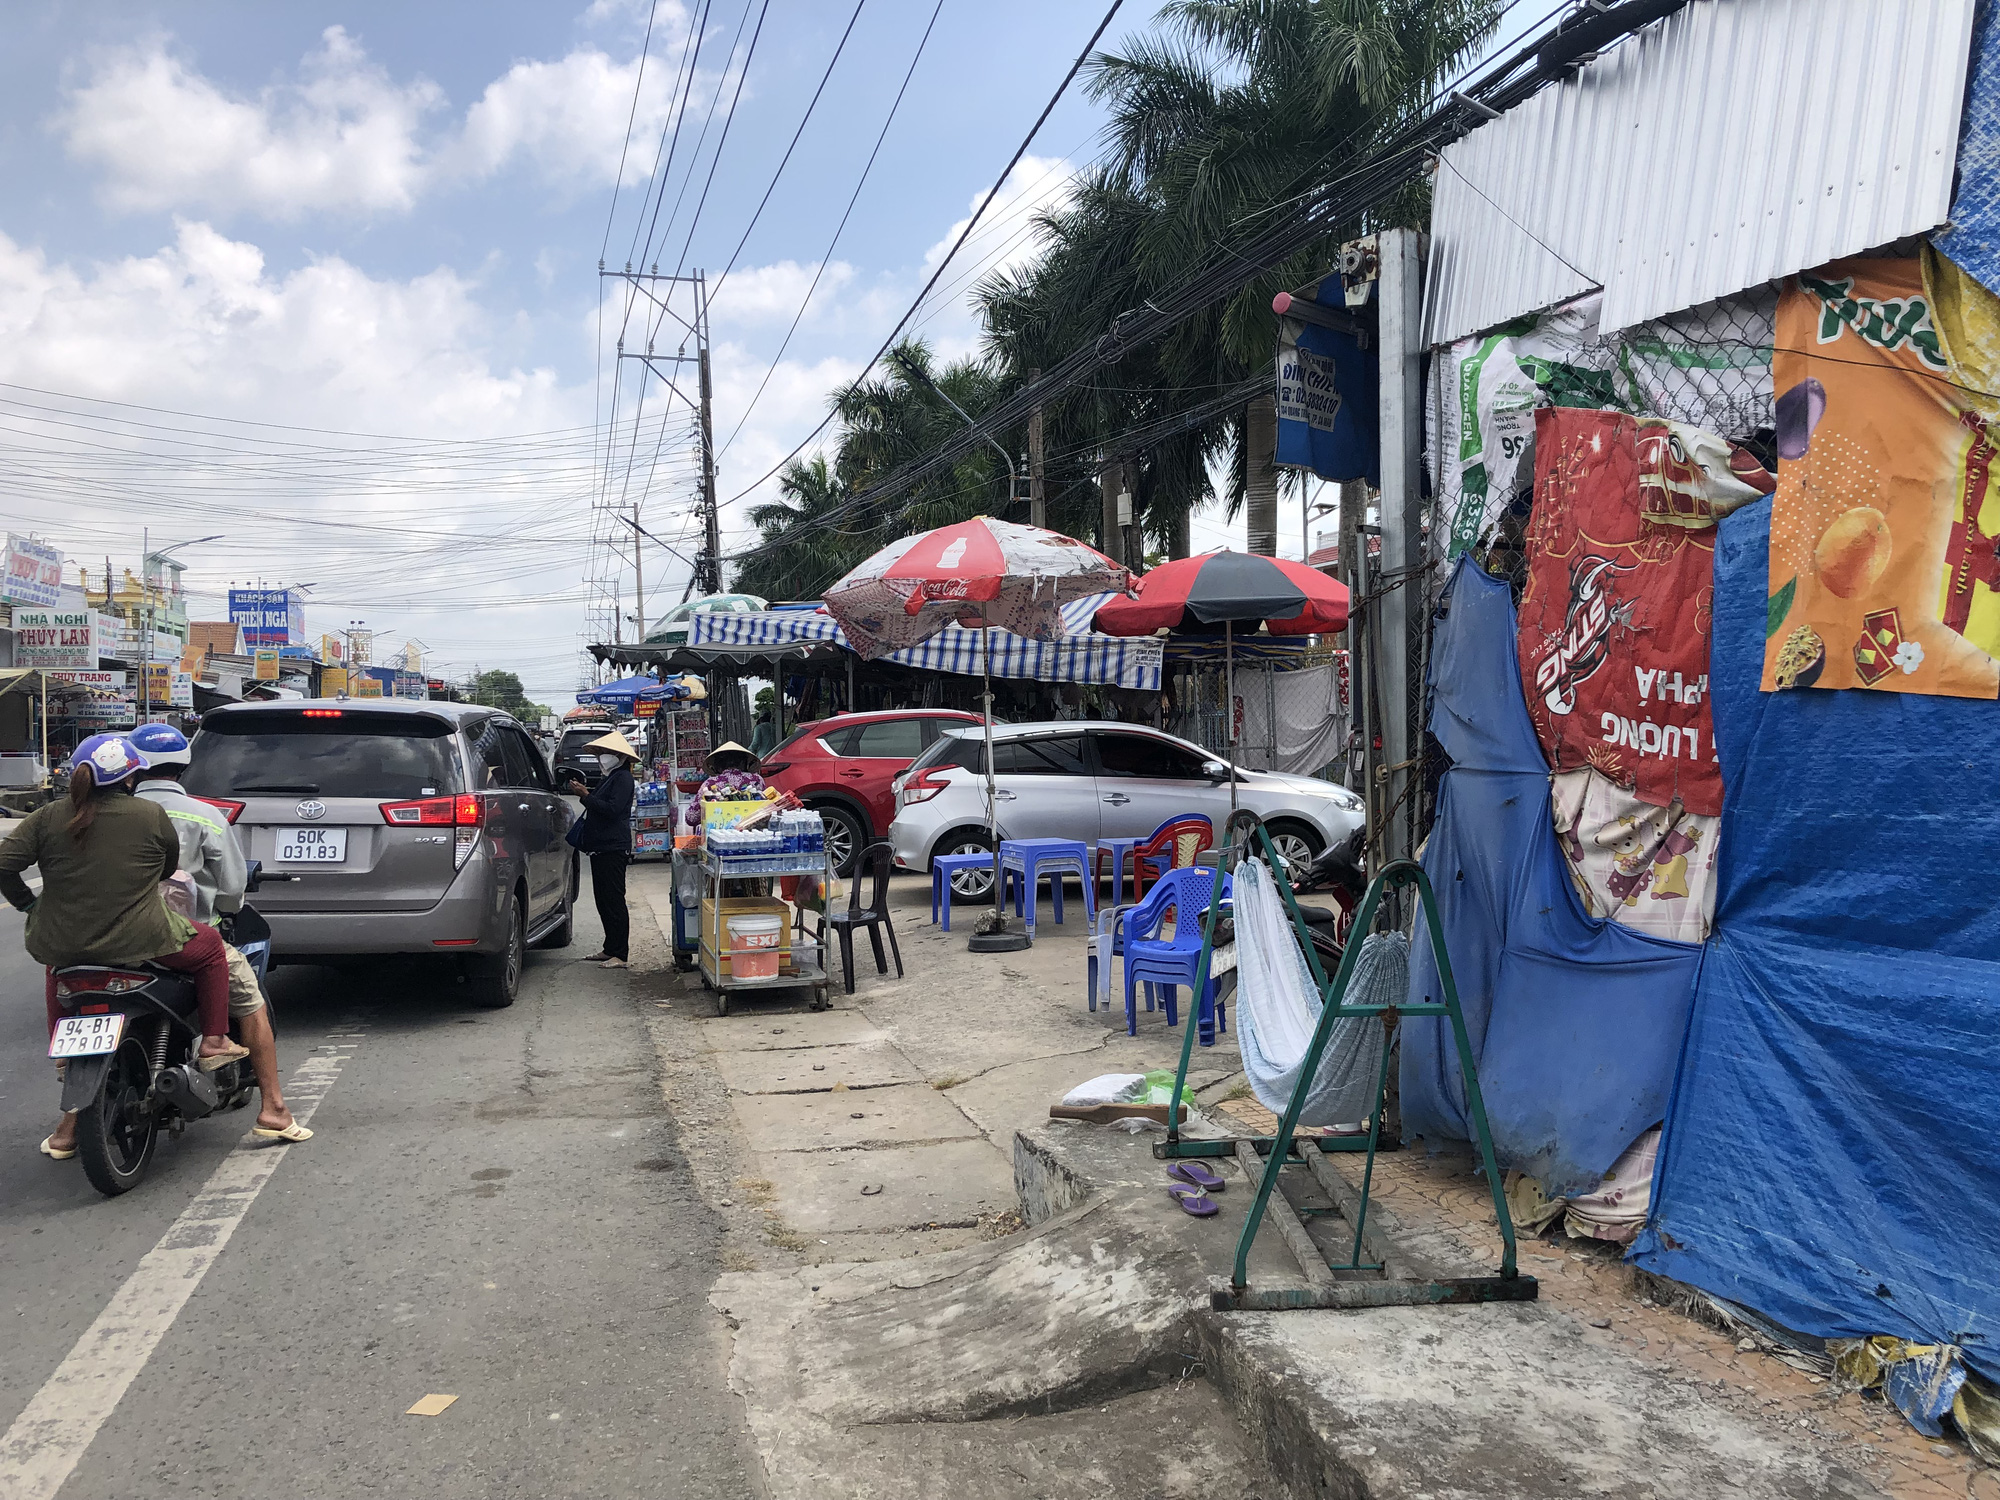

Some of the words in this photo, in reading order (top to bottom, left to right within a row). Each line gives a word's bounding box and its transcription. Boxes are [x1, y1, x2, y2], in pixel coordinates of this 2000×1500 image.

[20, 612, 48, 624] NHÀ
[54, 612, 90, 624] NGHỈ
[232, 607, 263, 628] THIÊN
[266, 611, 288, 628] NGA
[60, 629, 90, 645] LAN
[1537, 590, 1606, 691] STING
[79, 672, 112, 682] TRANG
[1635, 666, 1708, 706] PHÁ
[1601, 711, 1698, 761] LƯỢNG
[297, 830, 326, 844] 60K
[283, 845, 337, 859] 031.83
[65, 1017, 111, 1036] 94-B1
